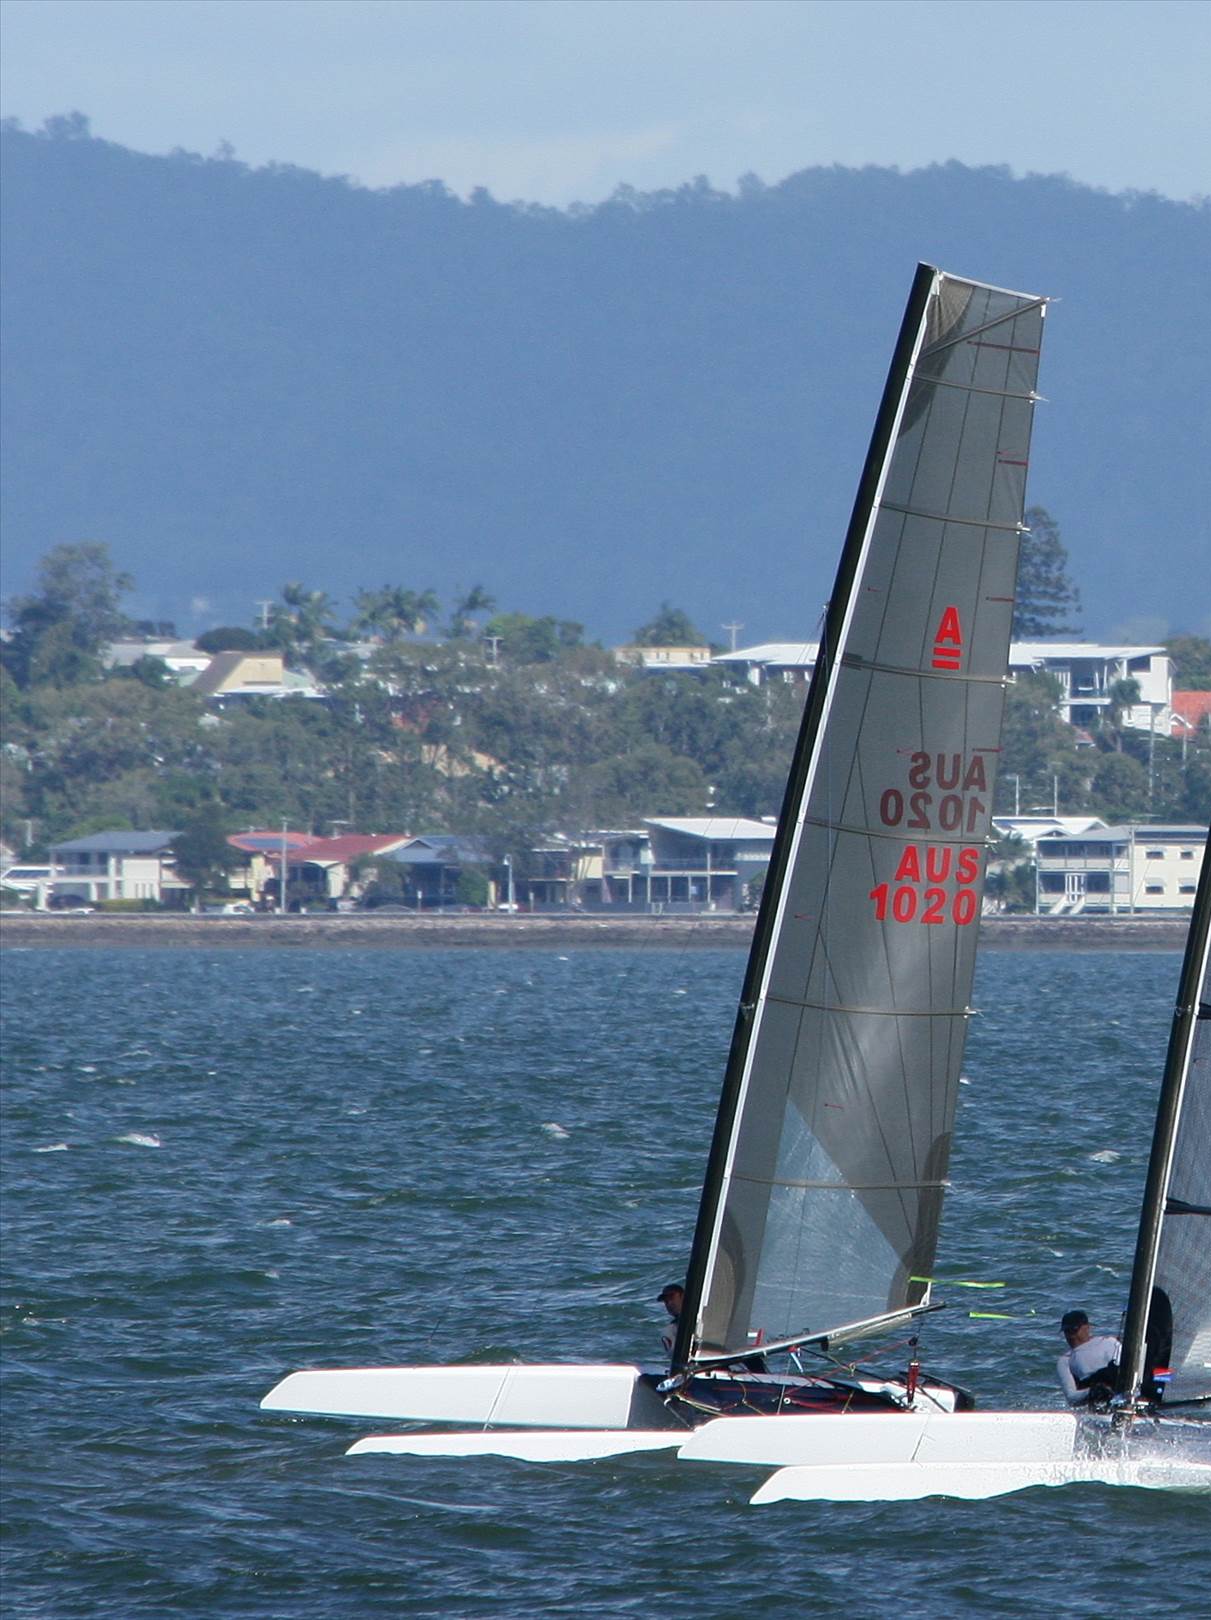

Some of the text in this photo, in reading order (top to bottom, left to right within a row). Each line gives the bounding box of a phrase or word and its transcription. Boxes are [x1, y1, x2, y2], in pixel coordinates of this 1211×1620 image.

[935, 606, 962, 645] A
[895, 845, 980, 884] AUS
[868, 883, 977, 925] 1020
